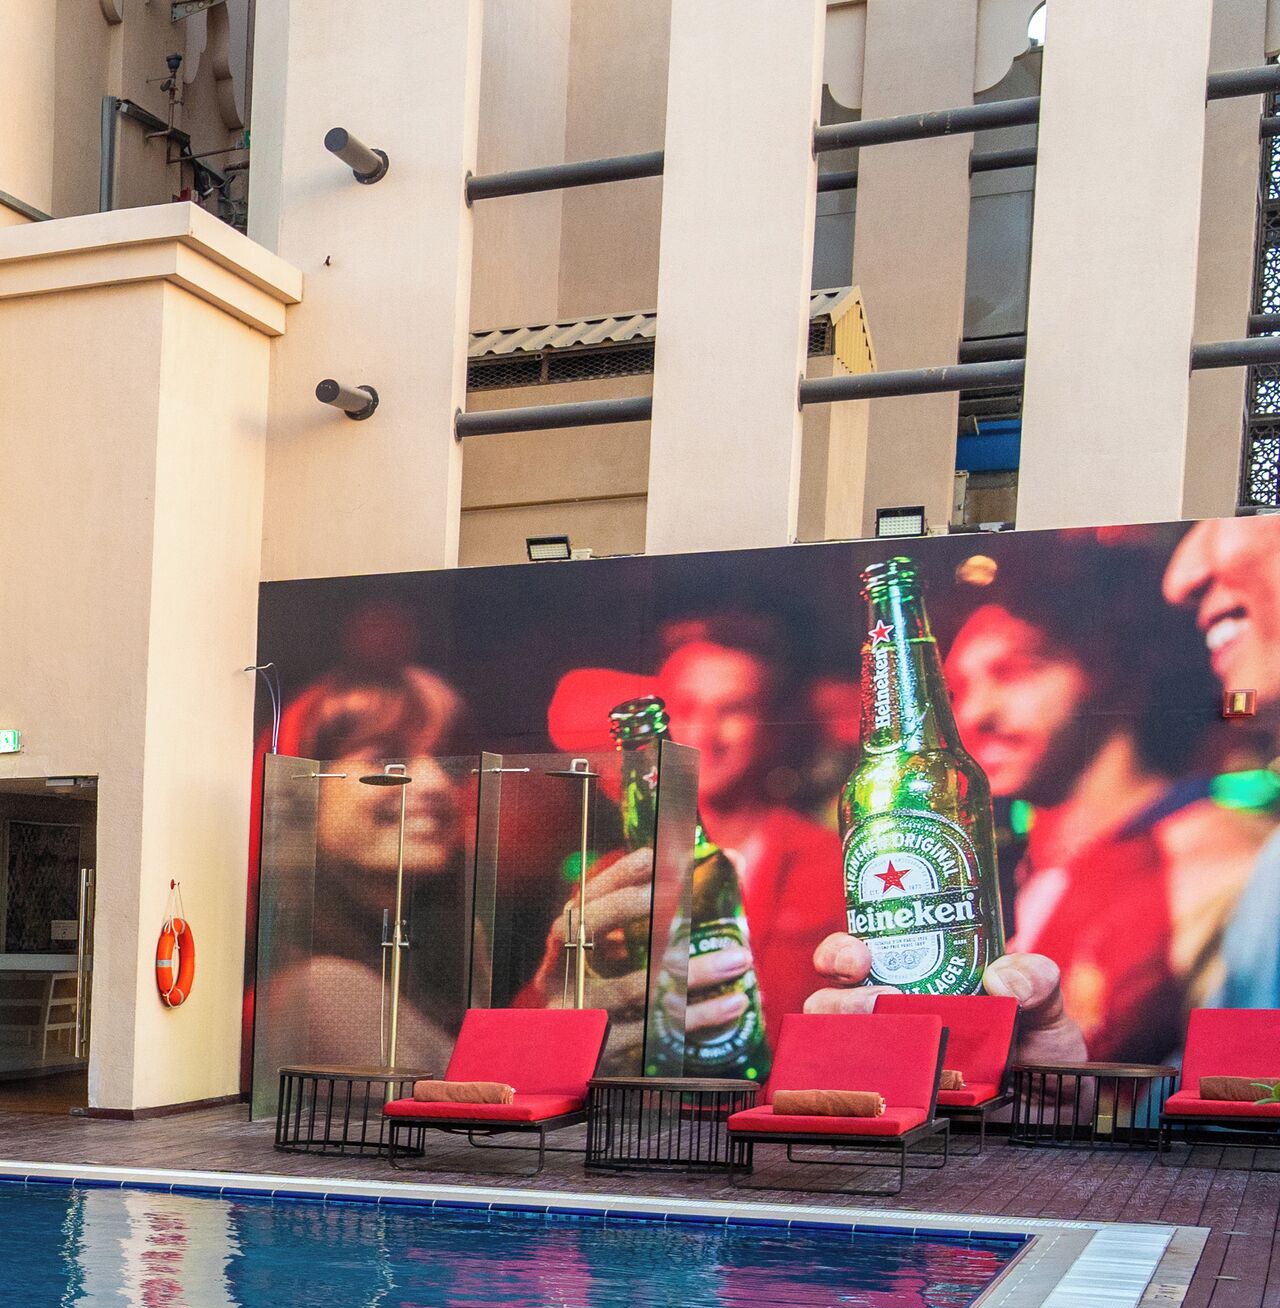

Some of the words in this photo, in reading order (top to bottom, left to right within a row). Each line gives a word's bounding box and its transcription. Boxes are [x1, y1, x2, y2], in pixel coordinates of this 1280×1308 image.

[874, 647, 892, 730] Heineken
[895, 832, 960, 878] ORIGINAL
[847, 899, 976, 935] Heineken
